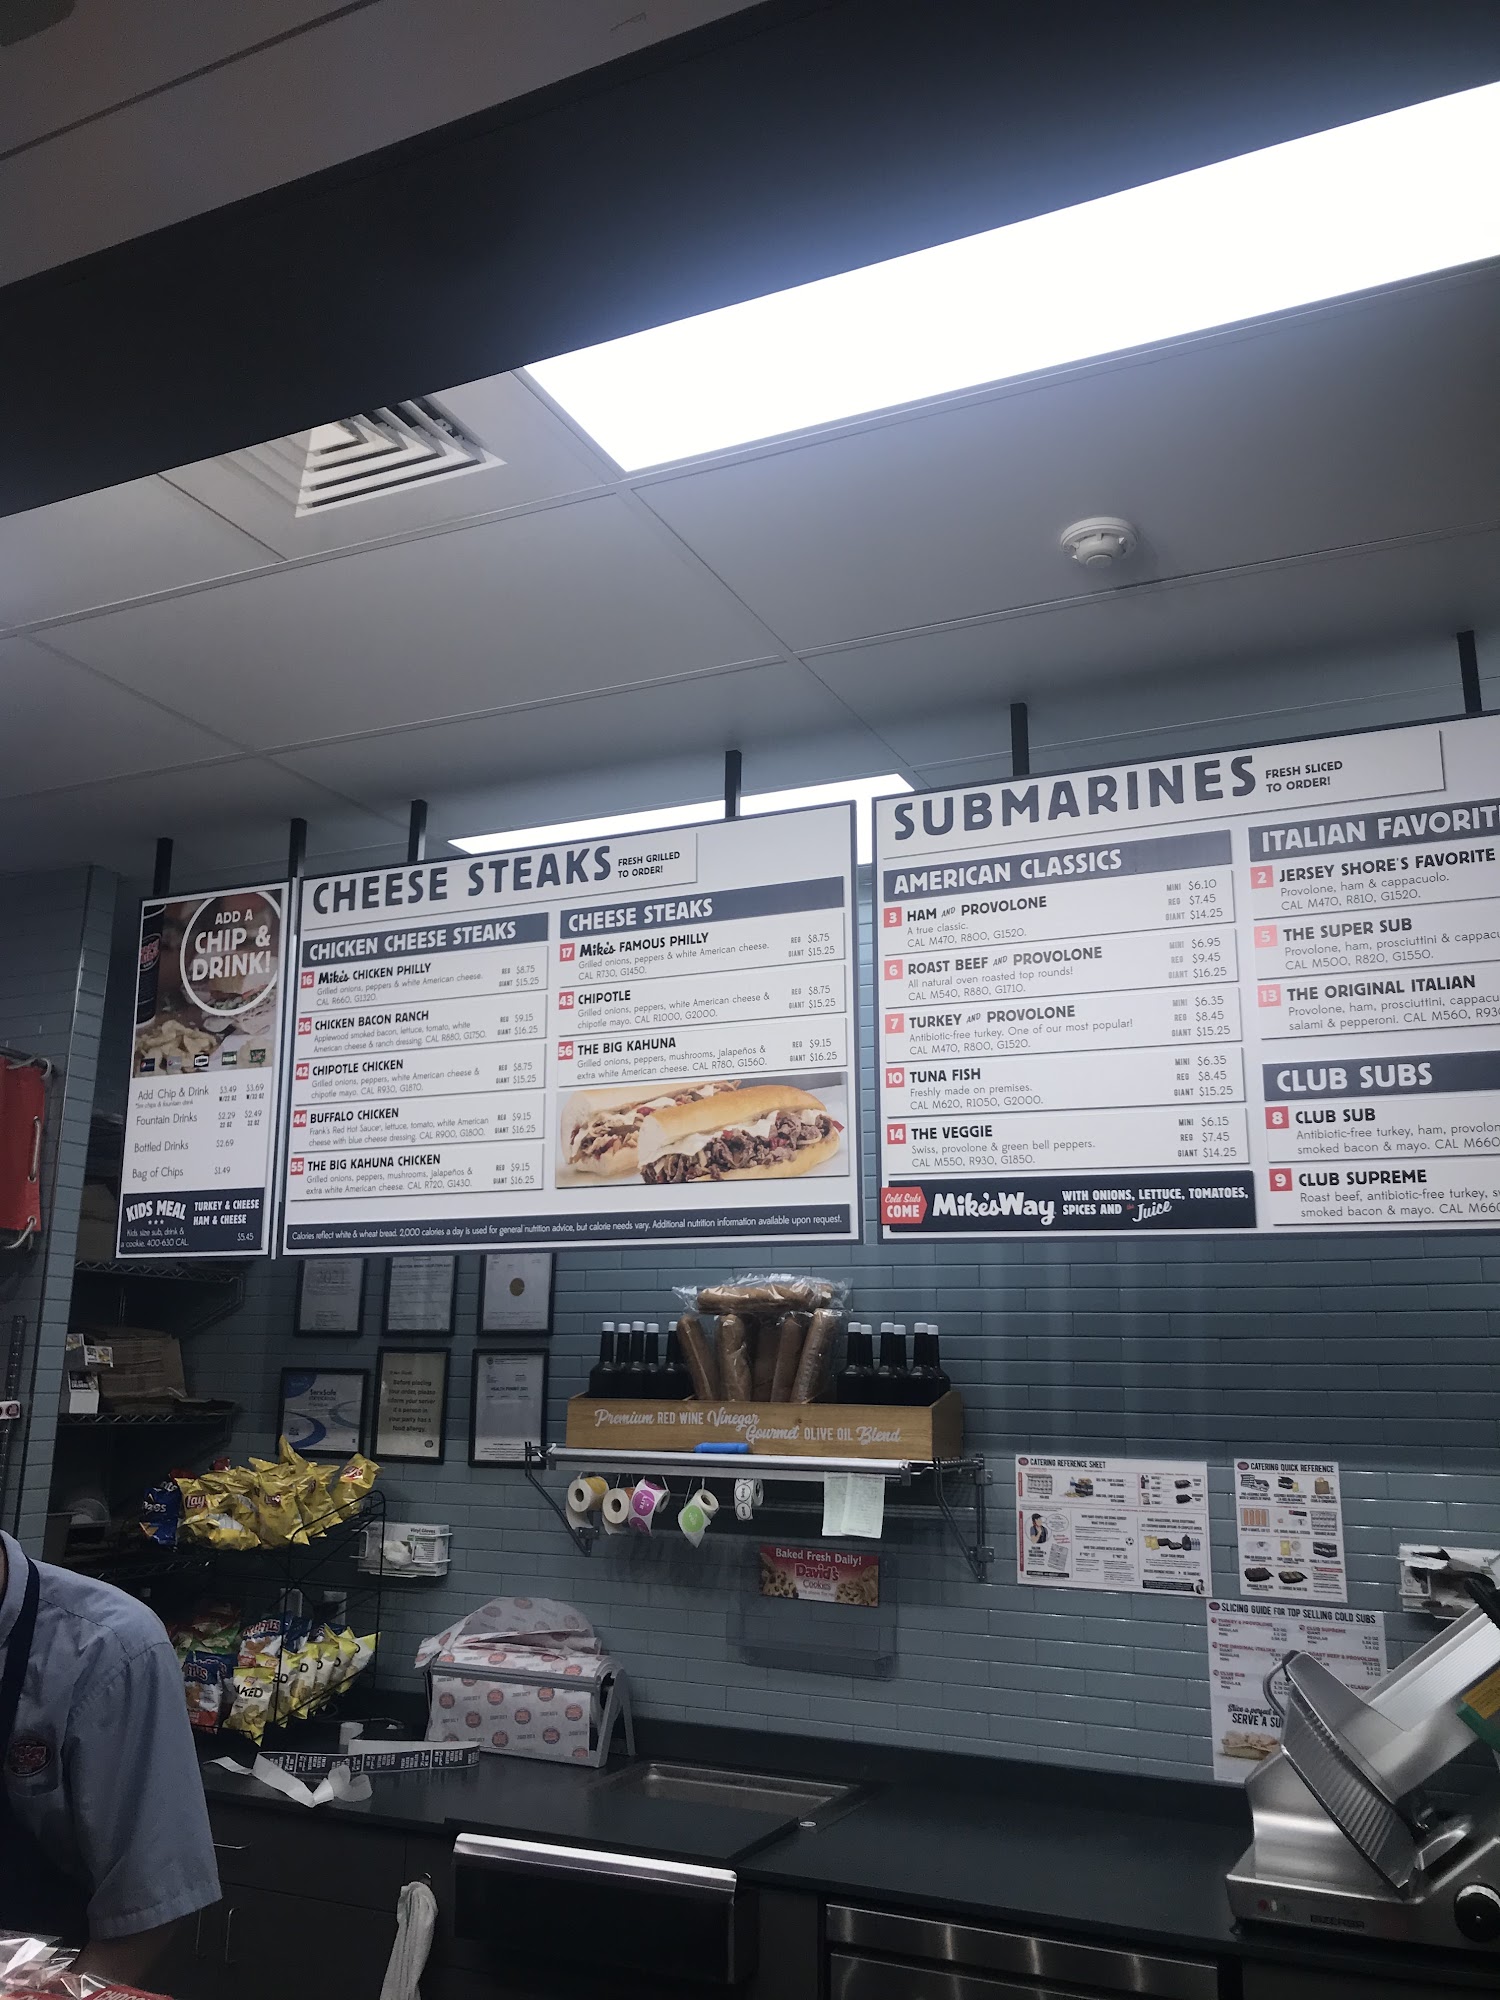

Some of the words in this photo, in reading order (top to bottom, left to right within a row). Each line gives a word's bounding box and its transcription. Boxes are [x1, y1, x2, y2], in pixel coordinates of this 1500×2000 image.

[1266, 766, 1301, 780] FRESH
[1305, 760, 1343, 774] SLICED
[1266, 783, 1282, 792] TO
[1286, 776, 1330, 790] ORDER!
[894, 755, 1256, 841] SUBMARINES
[1262, 820, 1366, 852] ITALIAN
[618, 856, 642, 867] FRESH
[646, 851, 680, 864] GRILLED
[1280, 864, 1334, 882] JERSEY
[1342, 856, 1410, 876] SHORE'S
[1415, 848, 1495, 869] FAVORITE
[618, 870, 629, 878] TO
[632, 865, 663, 878] ORDER!
[894, 864, 1011, 894] AMERICAN
[1020, 850, 1122, 879] CLASSICS
[313, 867, 447, 914] CHEESE
[468, 846, 611, 896] STEAKS
[1188, 879, 1216, 891] $6.10
[1189, 894, 1216, 905] $7.45
[216, 911, 240, 924] ADD
[245, 909, 253, 920] A
[568, 908, 637, 932] CHEESE
[644, 898, 712, 924] STEAKS
[907, 908, 936, 922] HAM
[942, 906, 956, 918] AND
[961, 896, 1047, 916] PROVOLONE
[1190, 908, 1223, 920] $14.25
[907, 926, 913, 935] A
[916, 923, 933, 934] true
[936, 920, 968, 933] classic.
[1283, 928, 1314, 941] THE
[1320, 921, 1374, 938] SUPER
[1380, 918, 1412, 933] SUB
[195, 928, 247, 954] CHIP
[256, 925, 270, 947] &
[309, 937, 378, 961] CHICKEN
[384, 930, 446, 952] CHEESE
[453, 921, 516, 945] STEAKS
[579, 942, 616, 958] Mike's
[619, 938, 666, 952] FAMOUS
[670, 932, 709, 946] PHILLY
[807, 933, 830, 944] $8.75
[192, 950, 270, 982] DRINK!
[908, 960, 950, 976] ROAST
[955, 957, 988, 971] BEEF
[993, 955, 1008, 967] AND
[1013, 947, 1102, 966] PROVOLONE
[318, 971, 350, 984] Mike's
[352, 967, 393, 981] CHICKEN
[396, 963, 432, 976] PHILLY
[1287, 986, 1318, 1001] THE
[1324, 980, 1404, 998] ORIGINAL
[1411, 975, 1476, 992] ITALIAN
[578, 990, 631, 1005] CHIPOTLE
[314, 1018, 354, 1030] CHICKEN
[358, 1014, 392, 1027] BACON
[395, 1010, 429, 1023] RANCH
[910, 1014, 962, 1029] TURKEY
[967, 1012, 980, 1024] AND
[987, 1005, 1075, 1023] PROVOLONE
[578, 1044, 599, 1056] THE
[602, 1041, 622, 1054] BIG
[627, 1037, 676, 1052] KAHUNA
[312, 1063, 358, 1076] CHIPOTLE
[362, 1059, 403, 1072] CHICKEN
[910, 1070, 947, 1083] TUNA
[952, 1068, 981, 1082] FISH
[1276, 1068, 1348, 1092] CLUB
[1360, 1062, 1432, 1088] SUBS
[138, 1090, 153, 1100] Add
[158, 1088, 176, 1100] Chip
[179, 1088, 185, 1096] &
[188, 1086, 208, 1096] Drink
[136, 1114, 170, 1125] Fountain
[173, 1112, 198, 1124] Drinks
[310, 1111, 354, 1124] BUFFALO
[357, 1108, 399, 1120] CHICKEN
[1295, 1110, 1336, 1124] CLUB
[1343, 1108, 1376, 1122] SUB
[912, 1127, 937, 1140] THE
[942, 1124, 992, 1138] VEGGIE
[134, 1141, 161, 1153] Bottled
[164, 1140, 188, 1151] Drinks
[1298, 1144, 1340, 1154] smoked
[1344, 1142, 1378, 1152] bacon
[1383, 1142, 1392, 1151] &
[1396, 1142, 1430, 1154] mayo.
[308, 1160, 326, 1172] THE
[329, 1158, 347, 1170] BIG
[350, 1156, 394, 1168] KAHUNA
[398, 1154, 440, 1166] CHICKEN
[132, 1168, 147, 1181] Bag
[150, 1167, 159, 1177] of
[161, 1166, 184, 1179] Chips
[1298, 1173, 1340, 1186] CLUB
[1346, 1170, 1427, 1185] SUPREME
[885, 1194, 902, 1204] Cold
[904, 1192, 922, 1204] Subs
[1062, 1190, 1088, 1202] WITH
[1092, 1189, 1135, 1202] ONIONS,
[1138, 1188, 1184, 1200] LETTUCE,
[1188, 1187, 1248, 1200] TOMATOES,
[126, 1201, 153, 1222] KIDS
[157, 1200, 186, 1220] MEAL
[194, 1201, 222, 1211] TURKEY
[225, 1201, 230, 1210] &
[233, 1200, 260, 1210] CHEESE
[886, 1205, 920, 1218] COME
[1062, 1204, 1097, 1216] SPICES
[1100, 1204, 1122, 1214] AND
[1132, 1202, 1172, 1222] Juice
[758, 1215, 789, 1226] available
[792, 1217, 811, 1226] upon
[813, 1214, 842, 1226] request.
[594, 1408, 655, 1428] Premium
[657, 1412, 675, 1424] RED
[679, 1412, 704, 1424] WINE
[707, 1407, 760, 1432] Vinegar
[745, 1424, 800, 1444] Gourmet
[804, 1427, 834, 1440] OLIVE
[837, 1428, 853, 1440] OIL
[856, 1426, 900, 1446] Blend
[1030, 1458, 1056, 1467] CATERING
[1057, 1459, 1088, 1468] REFERENCE
[1090, 1460, 1106, 1468] SHEET
[1251, 1462, 1278, 1470] CATERING
[1280, 1464, 1298, 1472] QUICK
[1300, 1464, 1334, 1472] REFERENCE
[776, 1548, 803, 1560] Baked
[807, 1551, 831, 1562] Fresh
[835, 1554, 862, 1568] Daily!
[795, 1562, 840, 1580] David's
[1222, 1603, 1248, 1614] SLICING
[1251, 1606, 1271, 1615] GUIDE
[1274, 1608, 1286, 1616] FOR
[1288, 1608, 1300, 1617] TOP
[1304, 1610, 1332, 1620] SELLING
[1335, 1612, 1353, 1622] COLD
[1356, 1614, 1376, 1624] SUBS
[234, 1685, 263, 1698] AKED
[1232, 1713, 1258, 1725] SERVE
[1262, 1716, 1267, 1726] A
